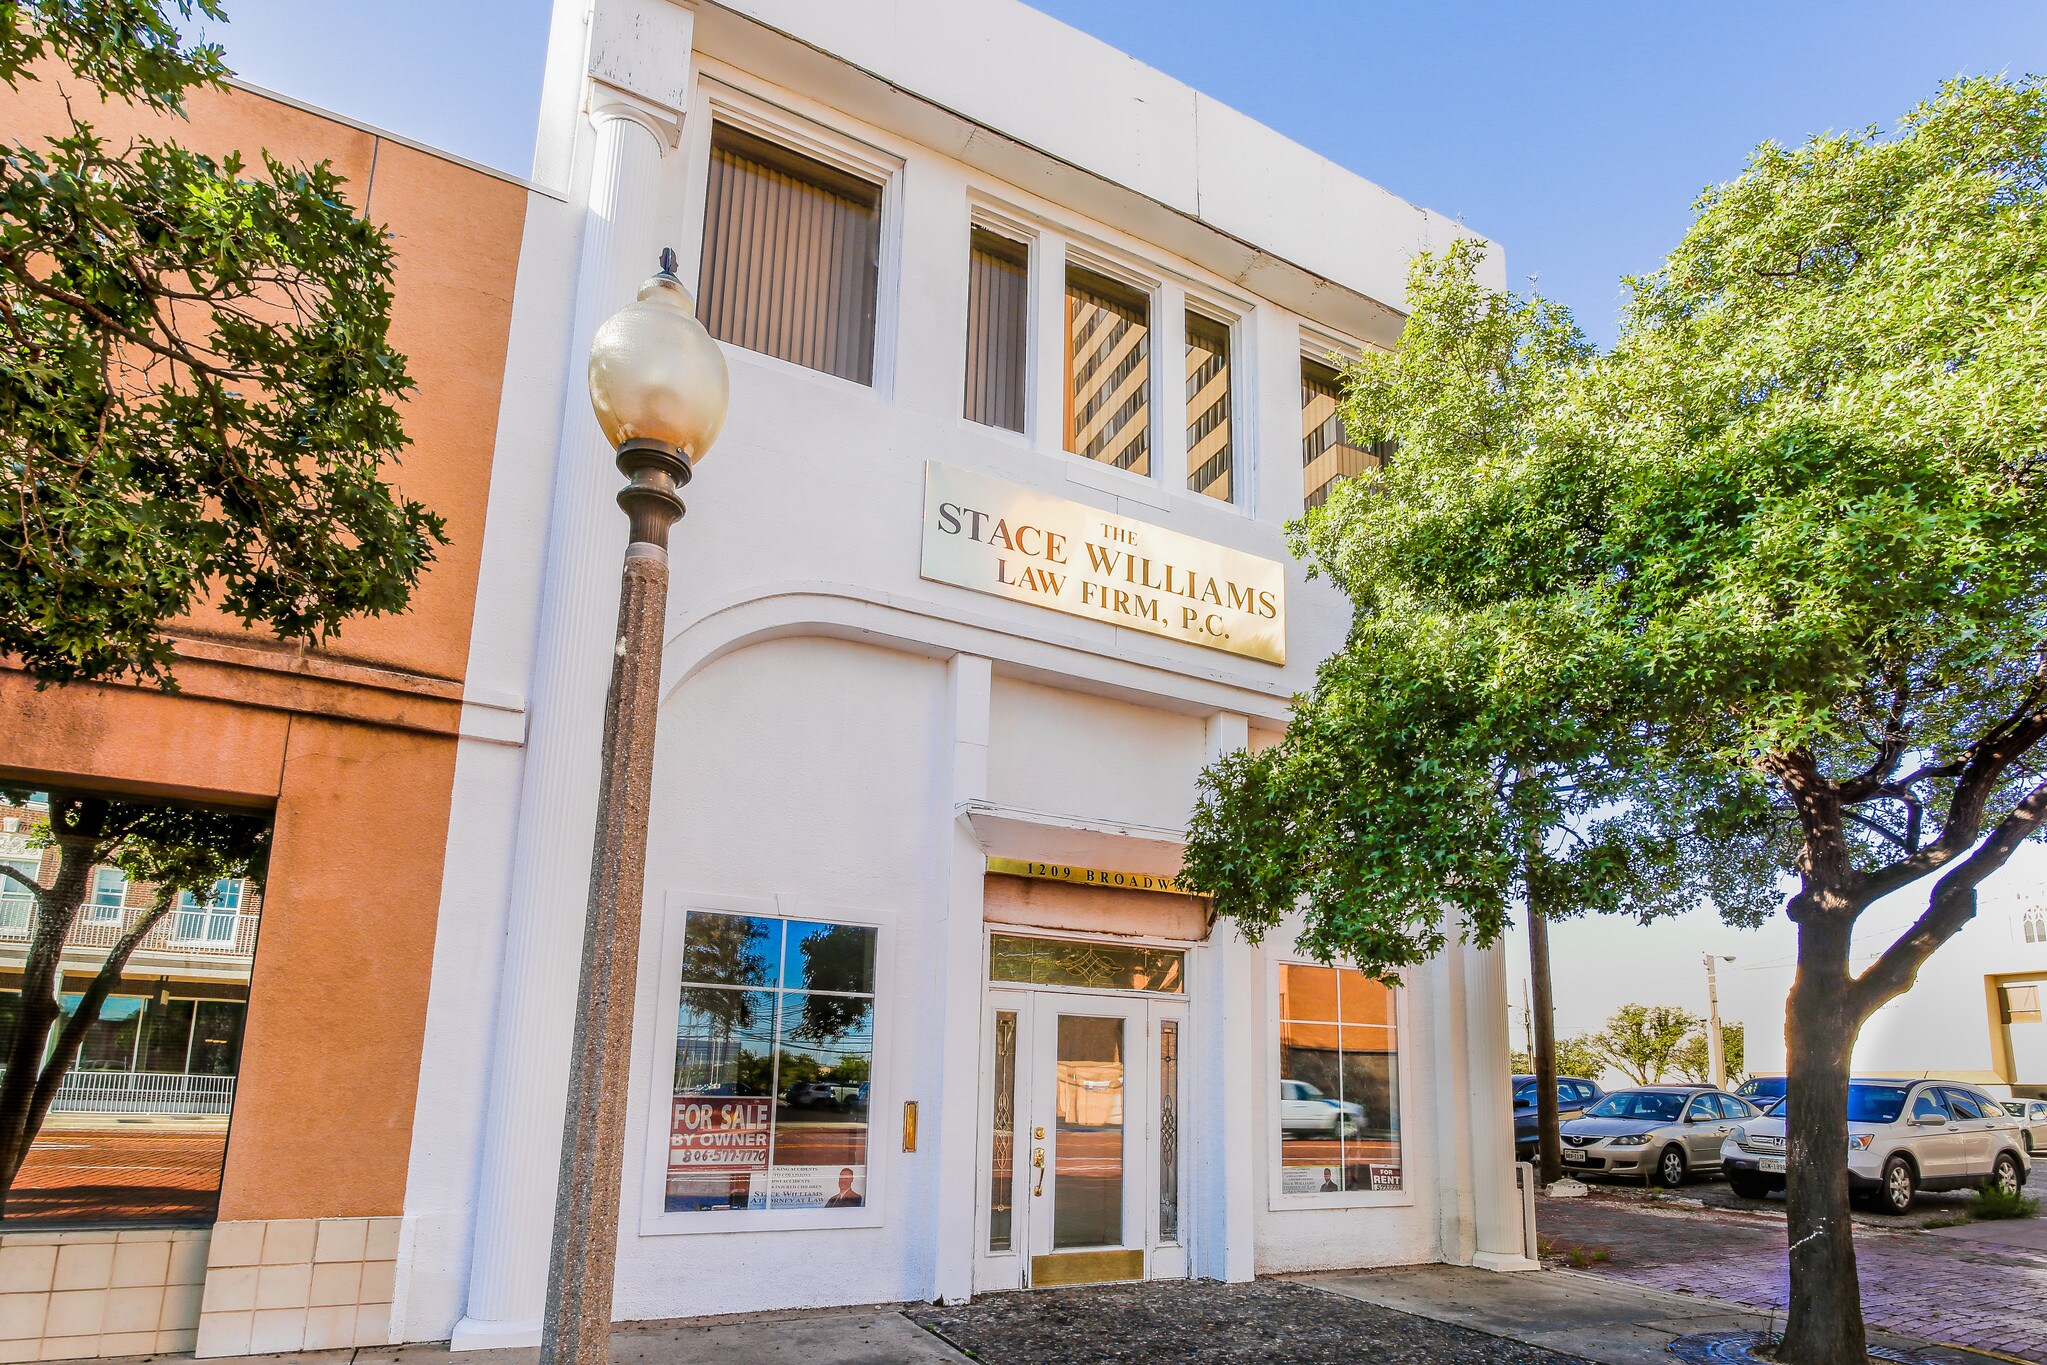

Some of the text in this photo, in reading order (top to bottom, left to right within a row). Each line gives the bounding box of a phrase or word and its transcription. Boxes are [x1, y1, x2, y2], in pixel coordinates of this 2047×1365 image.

[1100, 522, 1138, 547] THE
[937, 502, 1277, 620] STACE WILLIAMS
[995, 558, 1231, 640] LAW FIRM, P.C.
[1027, 862, 1071, 878] 1209
[673, 1103, 768, 1130] FOR SALE
[671, 1133, 767, 1147] BY OWNER
[1373, 1175, 1400, 1185] RENT
